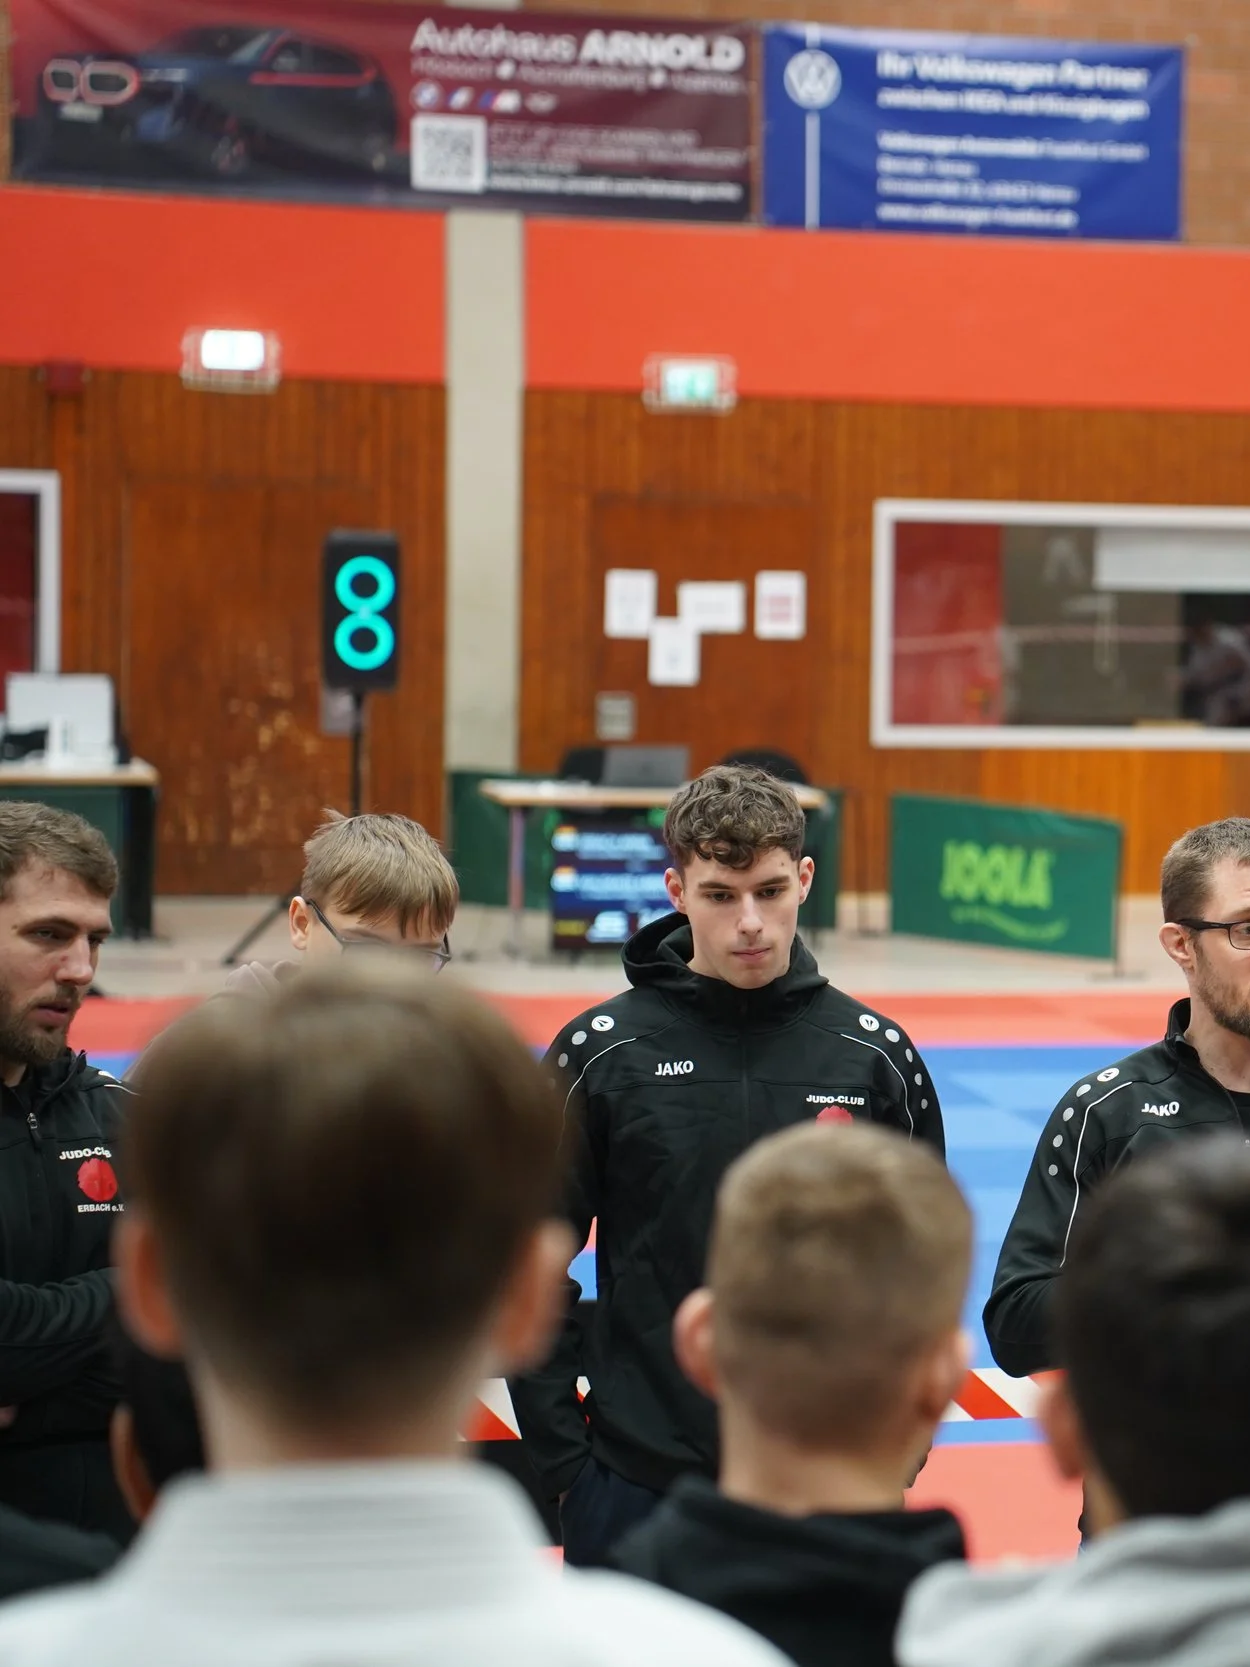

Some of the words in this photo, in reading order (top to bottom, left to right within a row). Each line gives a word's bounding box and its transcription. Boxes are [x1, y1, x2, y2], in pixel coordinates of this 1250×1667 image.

[411, 19, 577, 62] Autohaus
[579, 29, 745, 71] ARNOLD
[915, 51, 1056, 90] Volkswagen
[1059, 59, 1149, 91] Partner
[940, 839, 1055, 911] JOOLA
[654, 1060, 694, 1076] JAKO
[805, 1094, 865, 1106] JUDO-CLUB
[1141, 1101, 1180, 1117] JAKO
[77, 1203, 111, 1213] ERBACH
